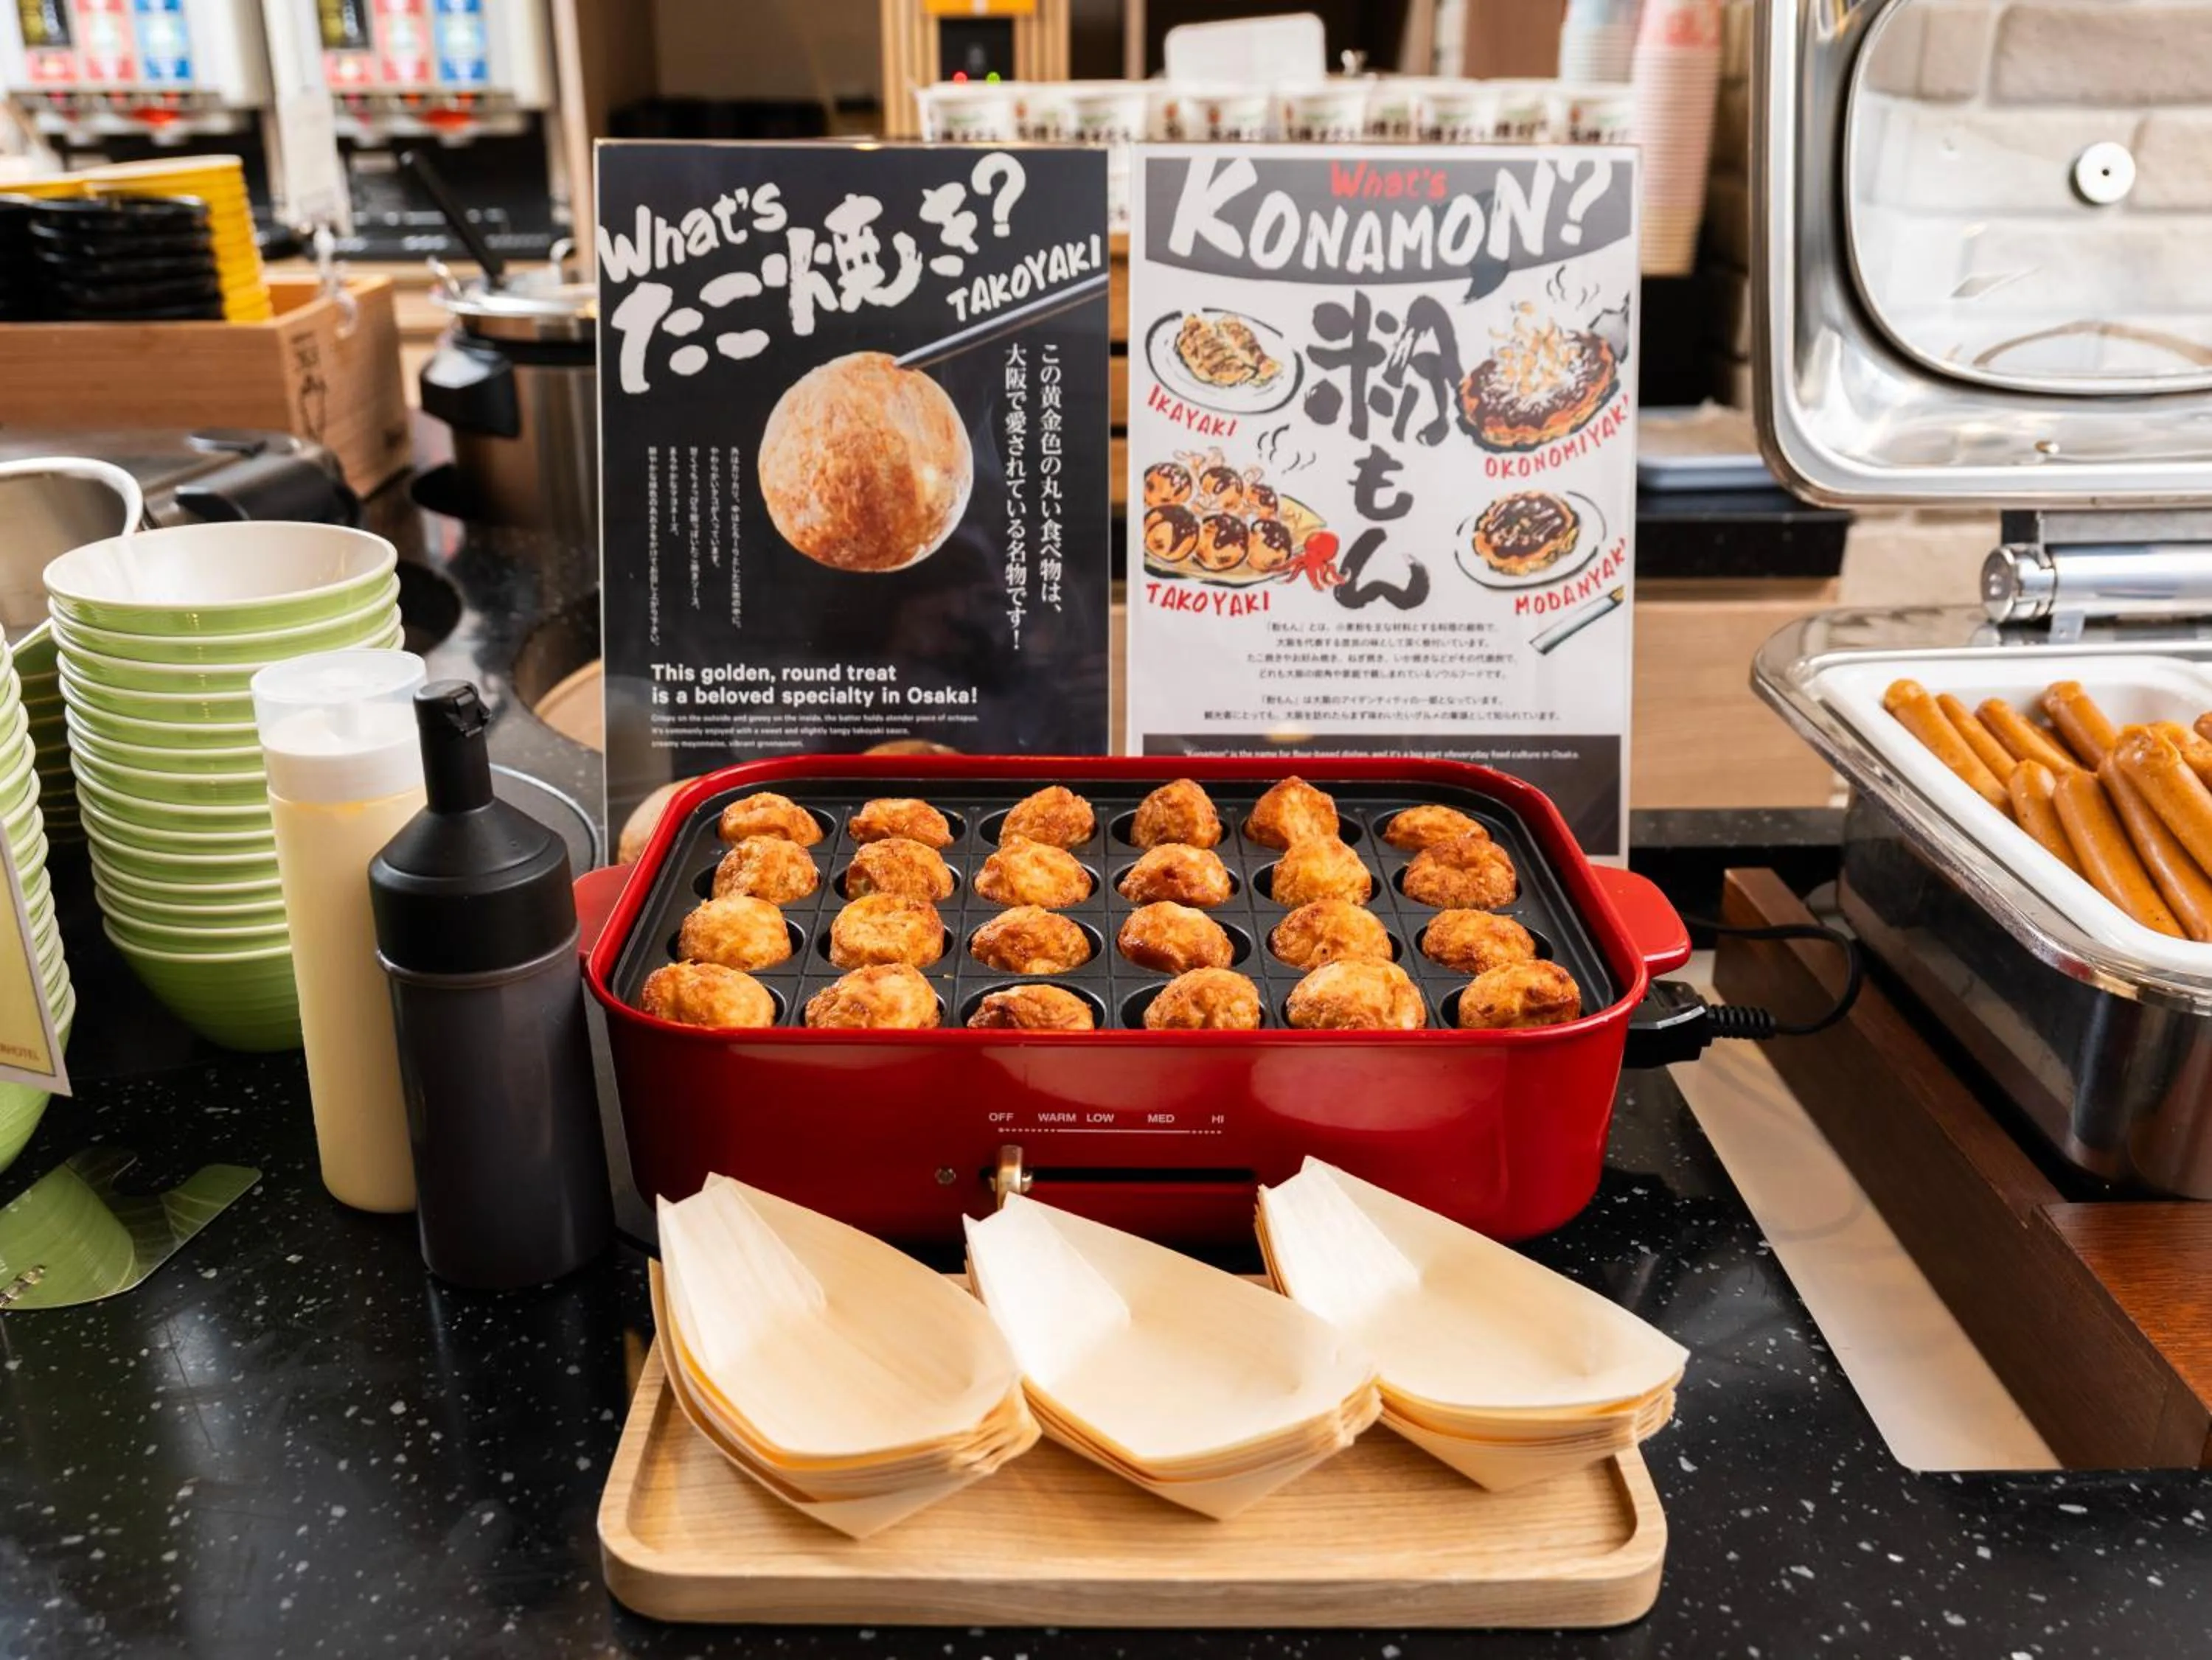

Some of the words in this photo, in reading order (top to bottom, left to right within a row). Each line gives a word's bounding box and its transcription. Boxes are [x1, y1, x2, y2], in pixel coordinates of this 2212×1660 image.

[1330, 159, 1447, 200] What's
[599, 182, 789, 283] What's
[1169, 157, 1613, 273] KONAMON?
[946, 234, 1102, 322] TAKOYAKI
[1147, 383, 1237, 436] IKAYAKI
[1304, 290, 1465, 610] 粉もん
[1040, 343, 1062, 613] この黄金色の丸い食べ物は、
[1146, 583, 1270, 617] TAKOYAKI
[650, 663, 695, 682] This
[701, 663, 776, 686] golden,
[782, 663, 841, 682] round
[846, 664, 897, 682] treat
[652, 686, 669, 705] is
[675, 690, 688, 705] a
[695, 686, 775, 705] beloved
[782, 686, 874, 708] specialty
[881, 686, 900, 705] in
[907, 686, 978, 705] Osaka!
[988, 1112, 1014, 1122] OFF
[1037, 1112, 1077, 1123] WARM
[1086, 1113, 1114, 1123] LOW
[1147, 1114, 1175, 1123] MED
[1211, 1114, 1225, 1123] HI
